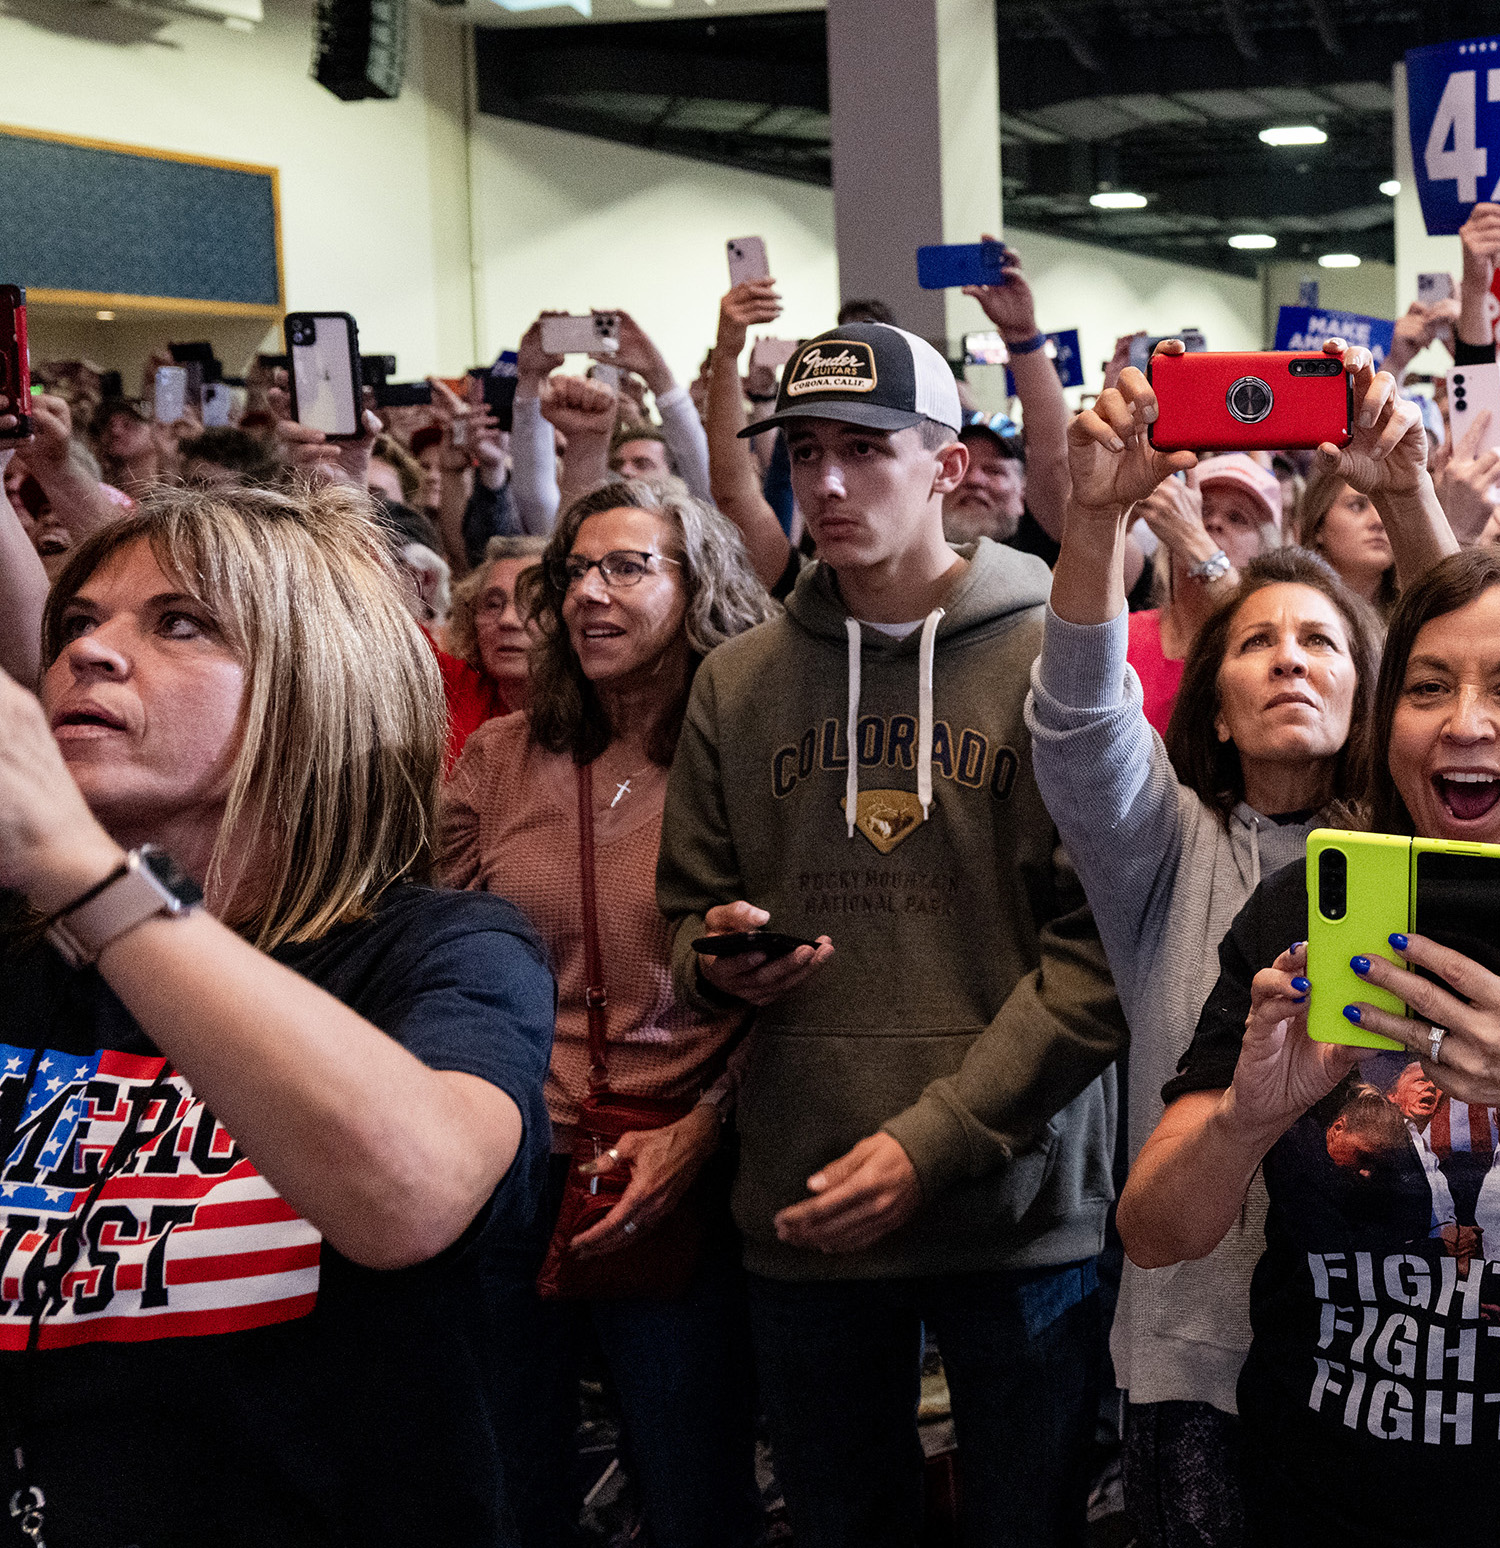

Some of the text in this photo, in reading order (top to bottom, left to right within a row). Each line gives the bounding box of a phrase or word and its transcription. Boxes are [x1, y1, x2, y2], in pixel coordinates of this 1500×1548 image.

[1308, 315, 1371, 346] MAKE
[802, 348, 866, 380] Fender
[812, 366, 858, 376] GUITARS
[771, 714, 1020, 800] COLORADO
